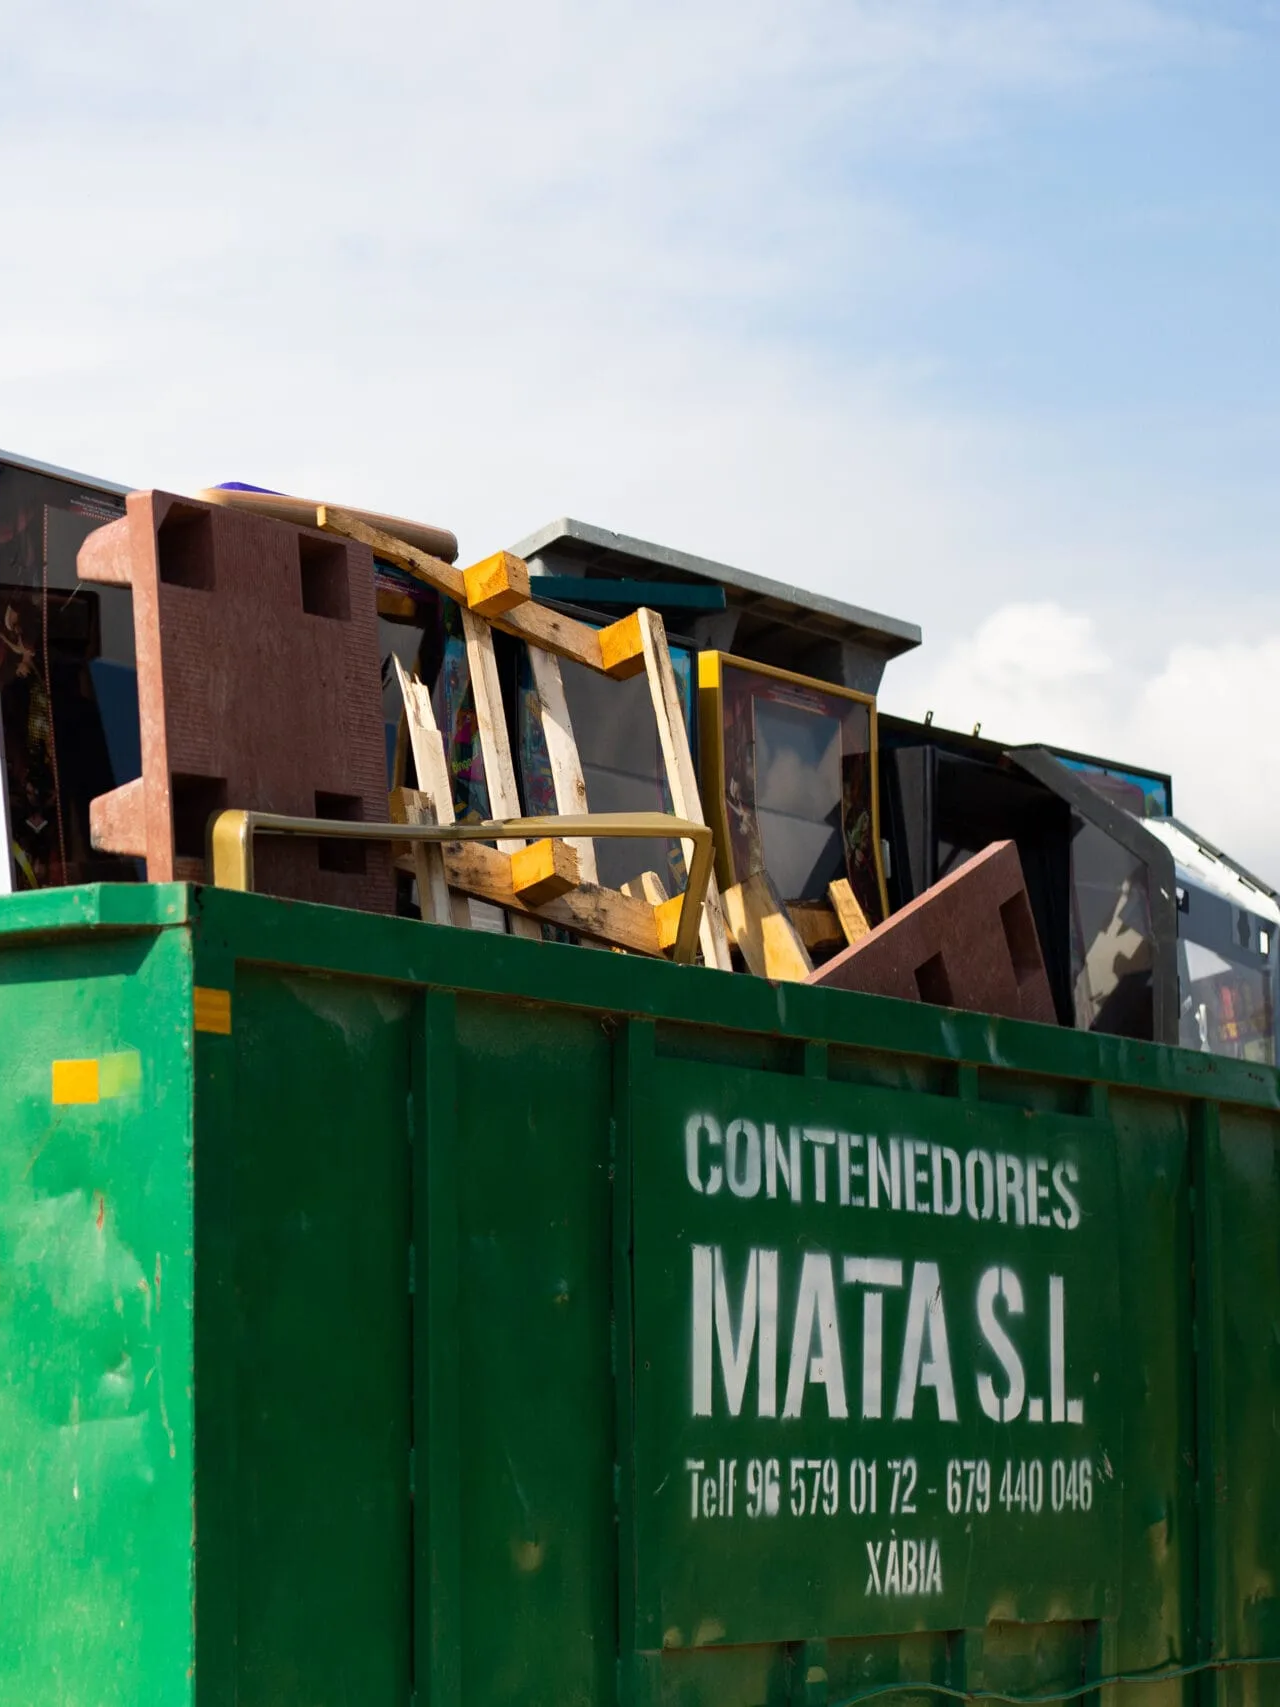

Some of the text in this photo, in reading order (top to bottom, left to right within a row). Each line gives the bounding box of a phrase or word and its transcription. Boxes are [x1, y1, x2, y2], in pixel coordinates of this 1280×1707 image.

[686, 1114, 1080, 1230] CONTENEDORES
[692, 1244, 959, 1423] MATA
[686, 1459, 737, 1519] Telf
[746, 1458, 780, 1517] 96
[790, 1458, 839, 1517] 579
[849, 1458, 877, 1515] 01
[887, 1458, 918, 1514] 72
[947, 1459, 991, 1514] 679
[999, 1459, 1044, 1514] 440
[1051, 1459, 1093, 1513] 046
